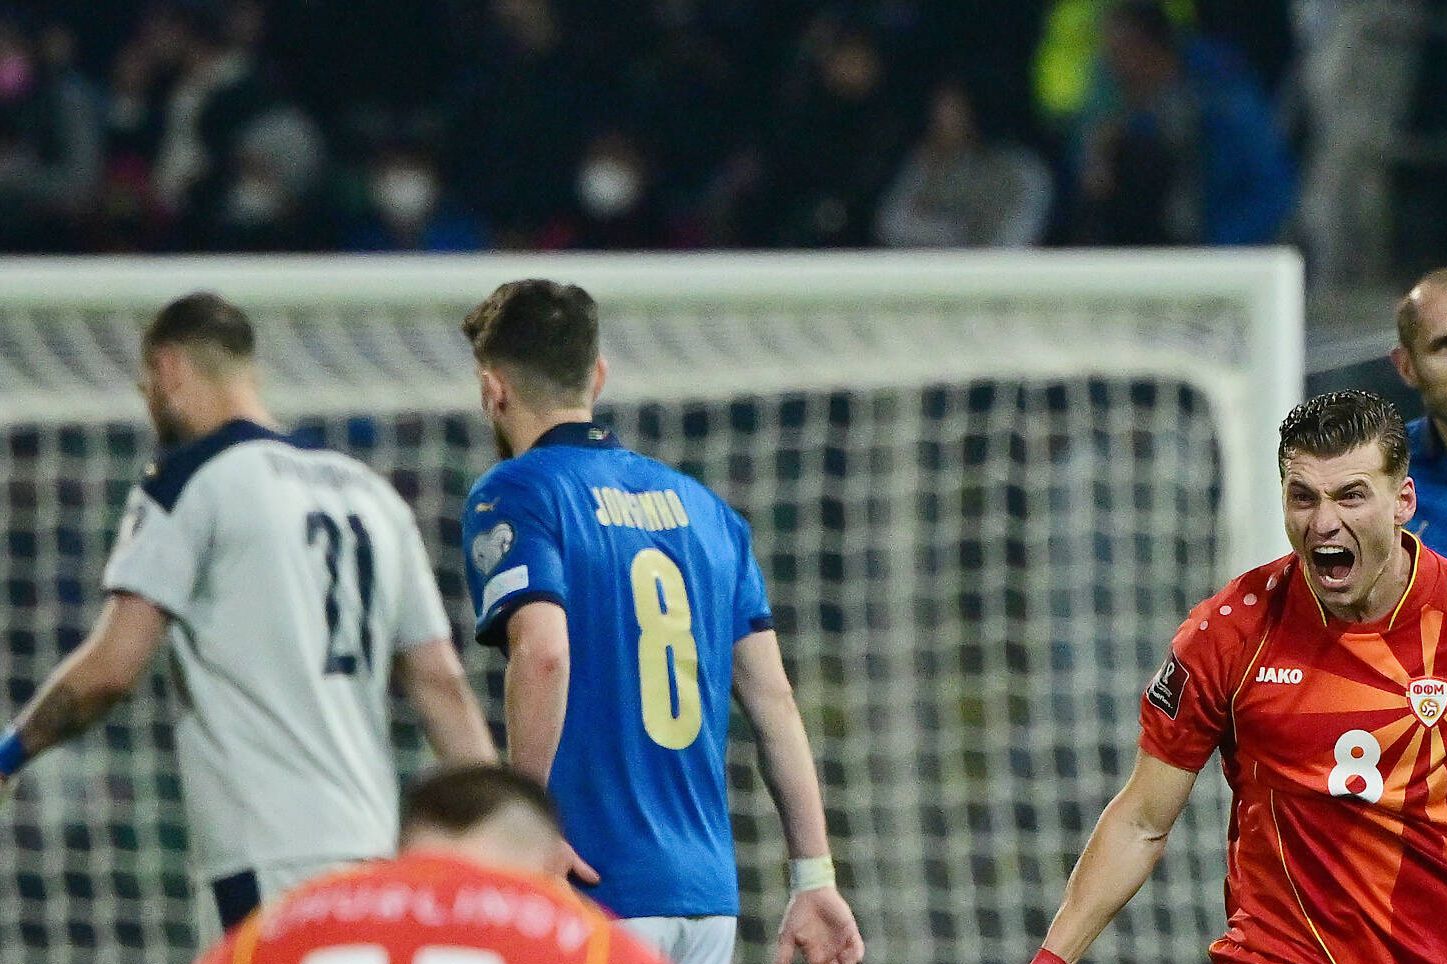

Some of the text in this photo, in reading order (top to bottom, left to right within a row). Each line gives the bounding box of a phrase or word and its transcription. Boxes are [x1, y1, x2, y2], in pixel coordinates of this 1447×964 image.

[630, 548, 702, 750] 8
[1256, 666, 1303, 684] JAKO
[1328, 730, 1384, 804] 8
